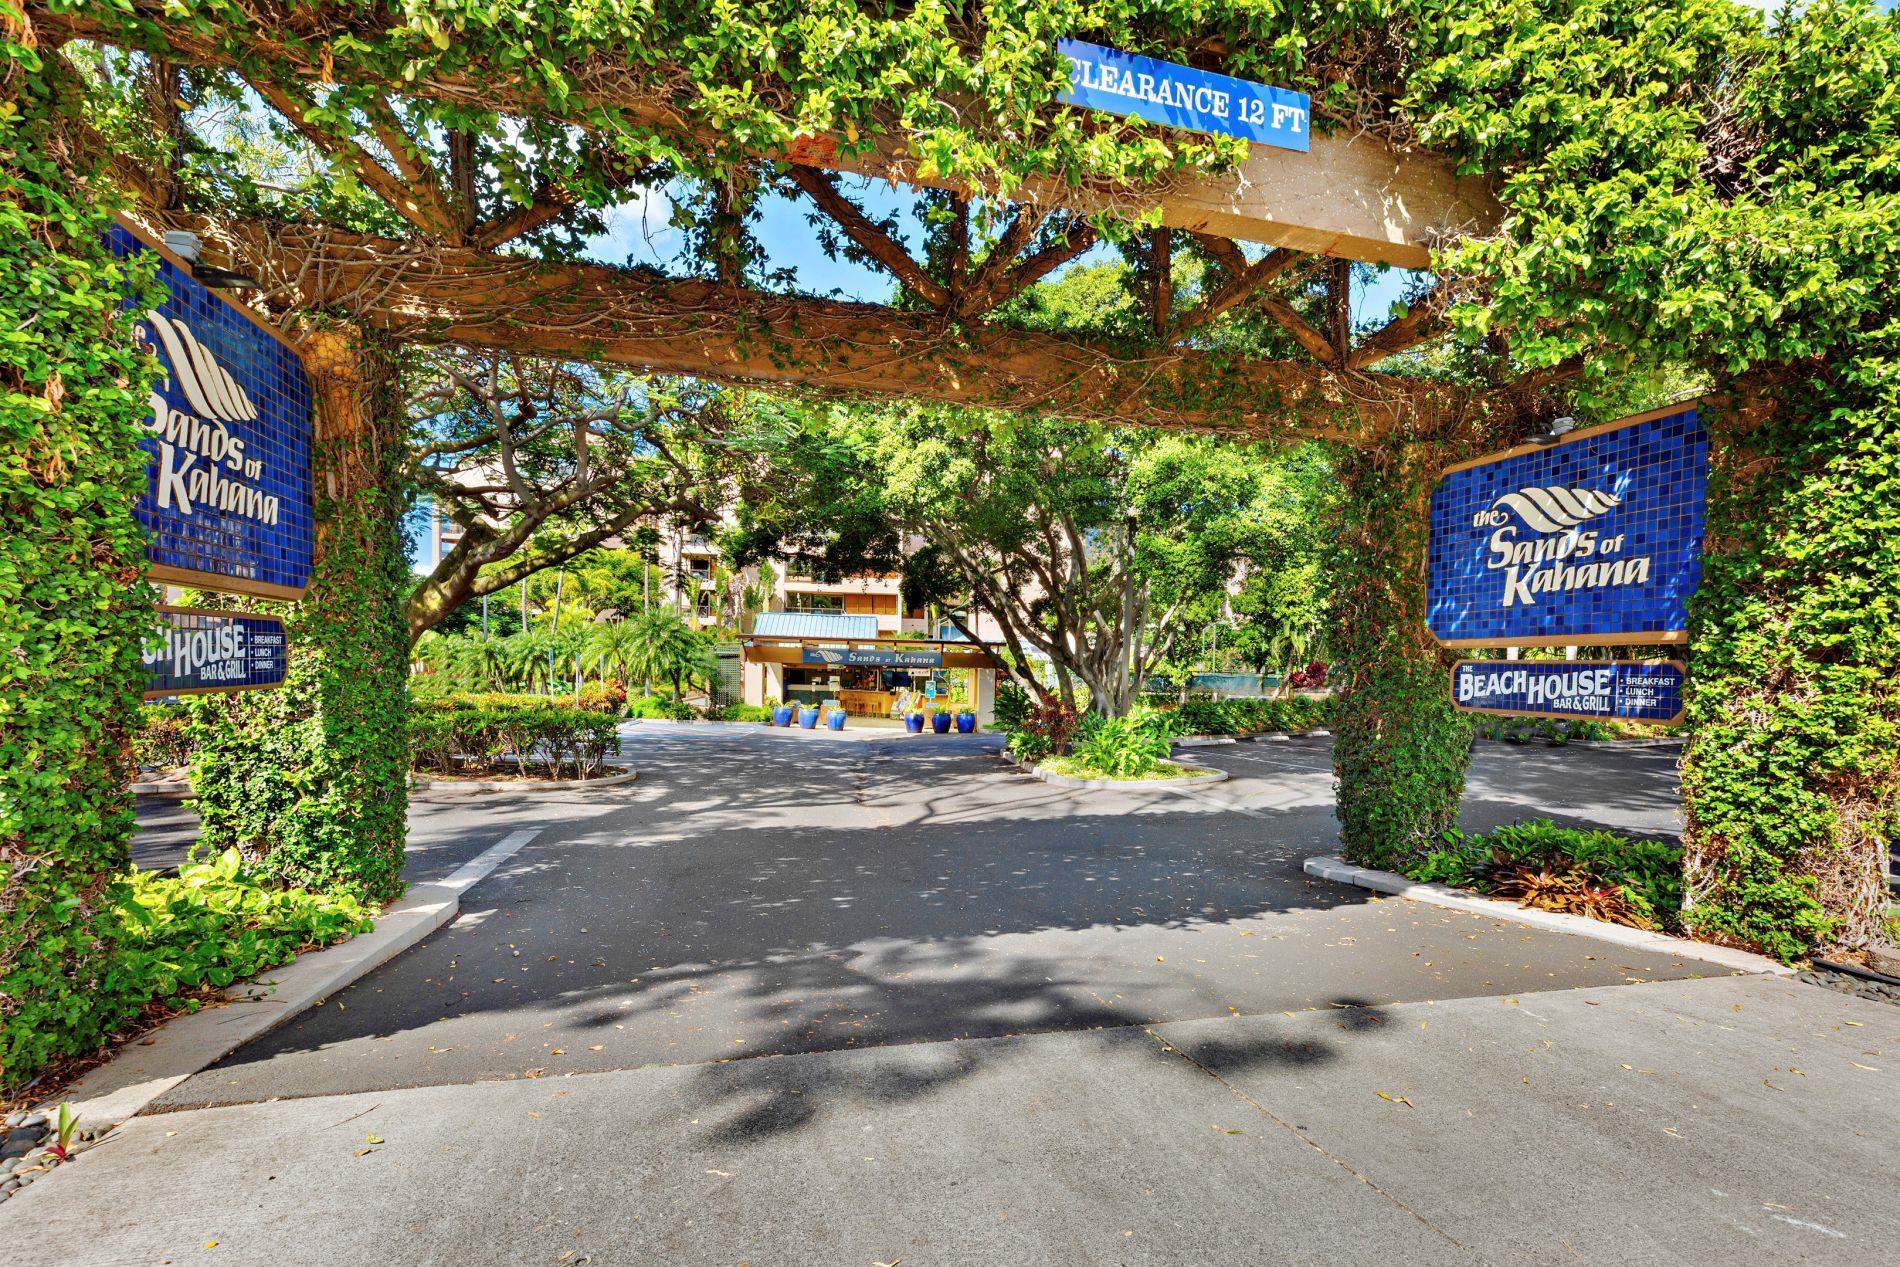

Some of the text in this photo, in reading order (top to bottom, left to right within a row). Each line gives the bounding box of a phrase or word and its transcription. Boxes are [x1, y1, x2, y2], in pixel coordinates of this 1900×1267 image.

[1065, 57, 1305, 133] CLEARANCE 12 FT
[245, 458, 263, 480] of
[157, 440, 279, 526] Kahana
[1473, 510, 1508, 528] the
[1488, 526, 1625, 568] Sands of
[1503, 556, 1650, 607] Kahana
[254, 635, 283, 645] BREAKFAST
[254, 648, 272, 657] LUNCH
[254, 660, 274, 670] DINNER
[1461, 665, 1474, 673] THE
[1626, 677, 1676, 686] BREAKFAST
[1625, 687, 1654, 696] LUNCH
[1625, 697, 1657, 707] DINNER
